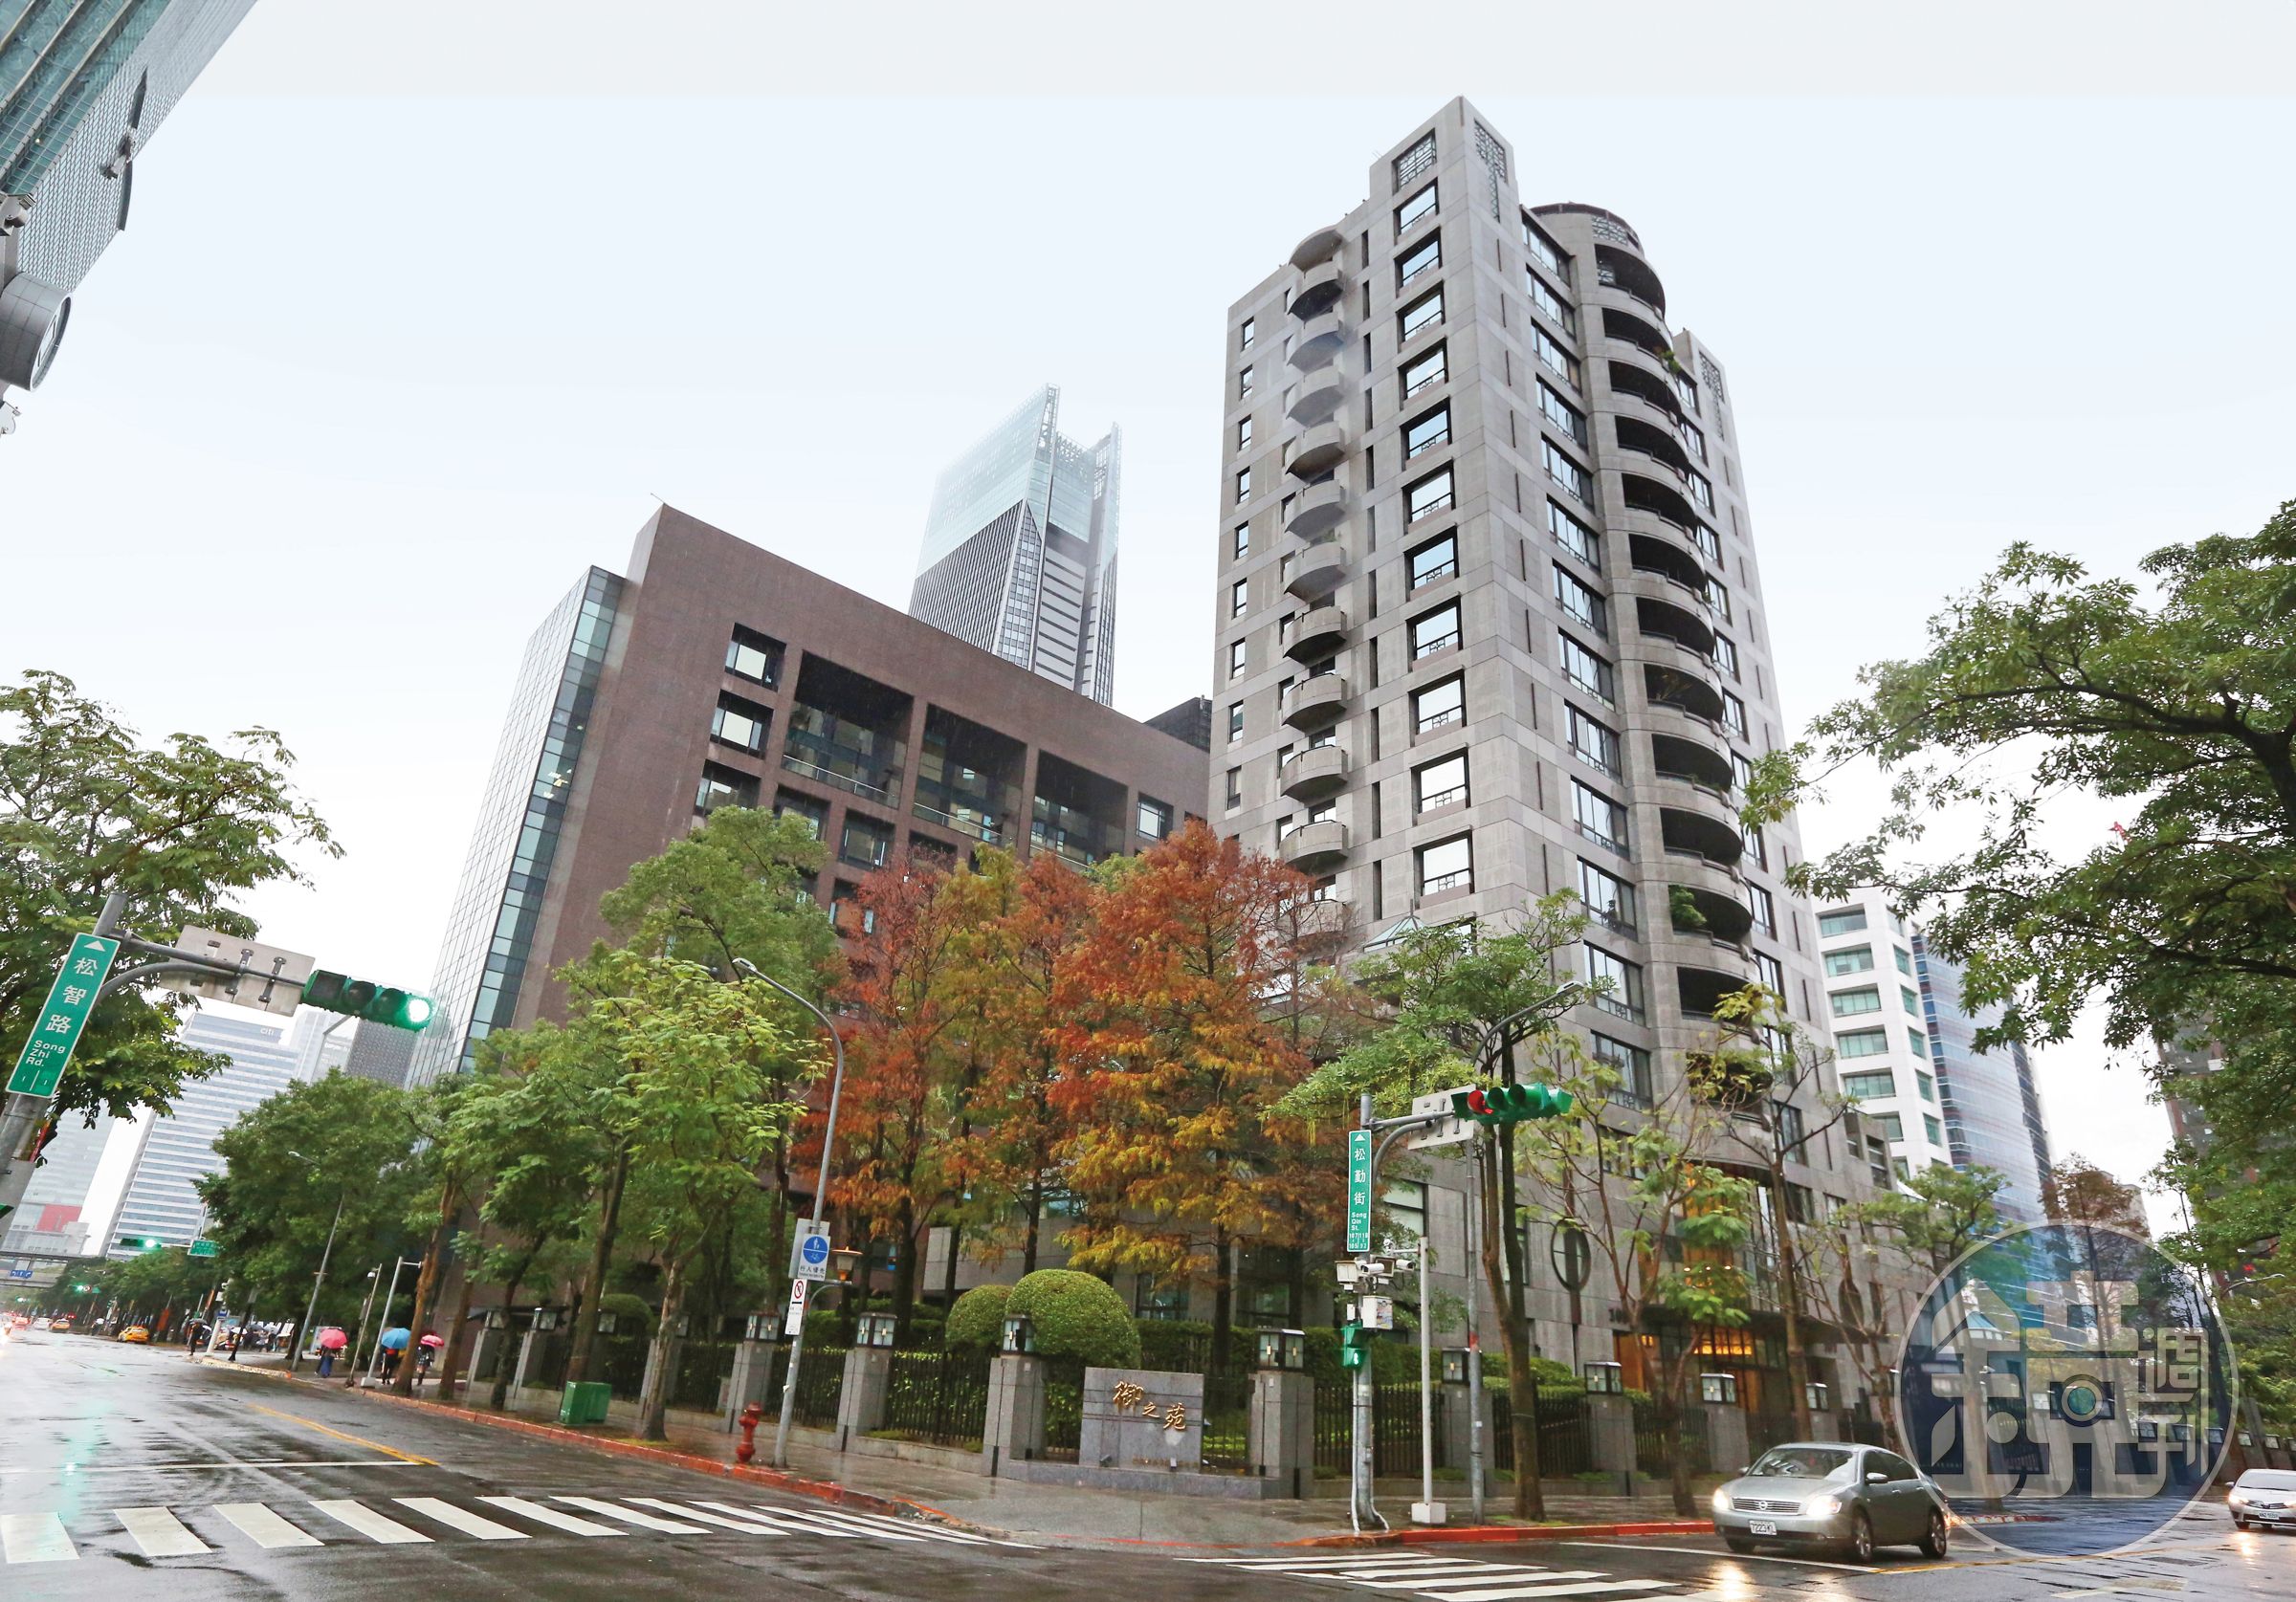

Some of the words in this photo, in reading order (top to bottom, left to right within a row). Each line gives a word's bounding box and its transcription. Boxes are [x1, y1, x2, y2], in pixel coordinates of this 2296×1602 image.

[46, 957, 99, 1034] 松智路
[29, 1048, 50, 1058] Zhi
[33, 1040, 66, 1054] Song
[25, 1056, 44, 1066] Rd.
[1354, 1148, 1366, 1205] 松勤街
